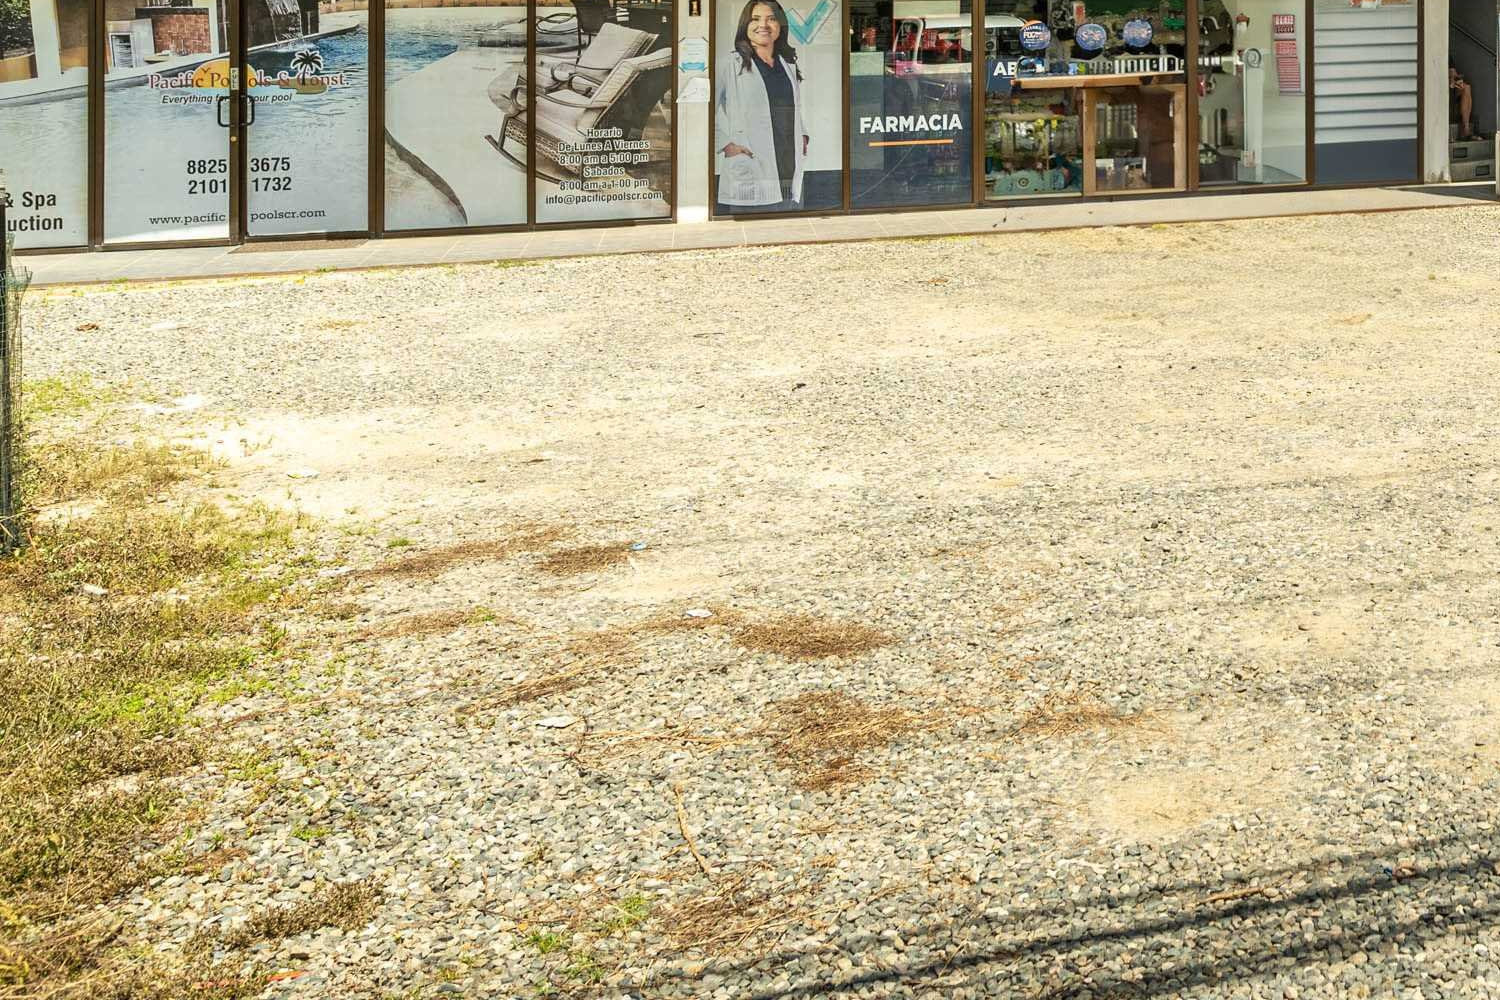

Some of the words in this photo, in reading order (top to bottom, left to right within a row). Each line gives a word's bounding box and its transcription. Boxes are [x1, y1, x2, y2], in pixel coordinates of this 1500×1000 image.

[149, 71, 205, 89] Pacific
[278, 72, 292, 86] &
[162, 94, 213, 105] Everything
[271, 93, 293, 103] pool
[859, 113, 963, 134] FARMACIA
[586, 128, 622, 137] Horario
[559, 143, 572, 152] De
[574, 142, 600, 151] Lunes
[604, 141, 612, 149] A
[614, 140, 649, 150] Viernes
[560, 155, 580, 164] 8:00
[609, 153, 631, 162] 5:00
[634, 154, 648, 163] pm
[187, 159, 227, 174] 8825
[250, 157, 291, 172] 3675
[584, 166, 625, 177] Sabados
[188, 179, 227, 194] 2101
[252, 176, 292, 192] 1732
[560, 181, 580, 190] 8:00
[634, 179, 648, 188] pm
[22, 191, 57, 210] Spa
[545, 191, 663, 204] info@pacificpoolscr.com
[7, 215, 63, 232] uction
